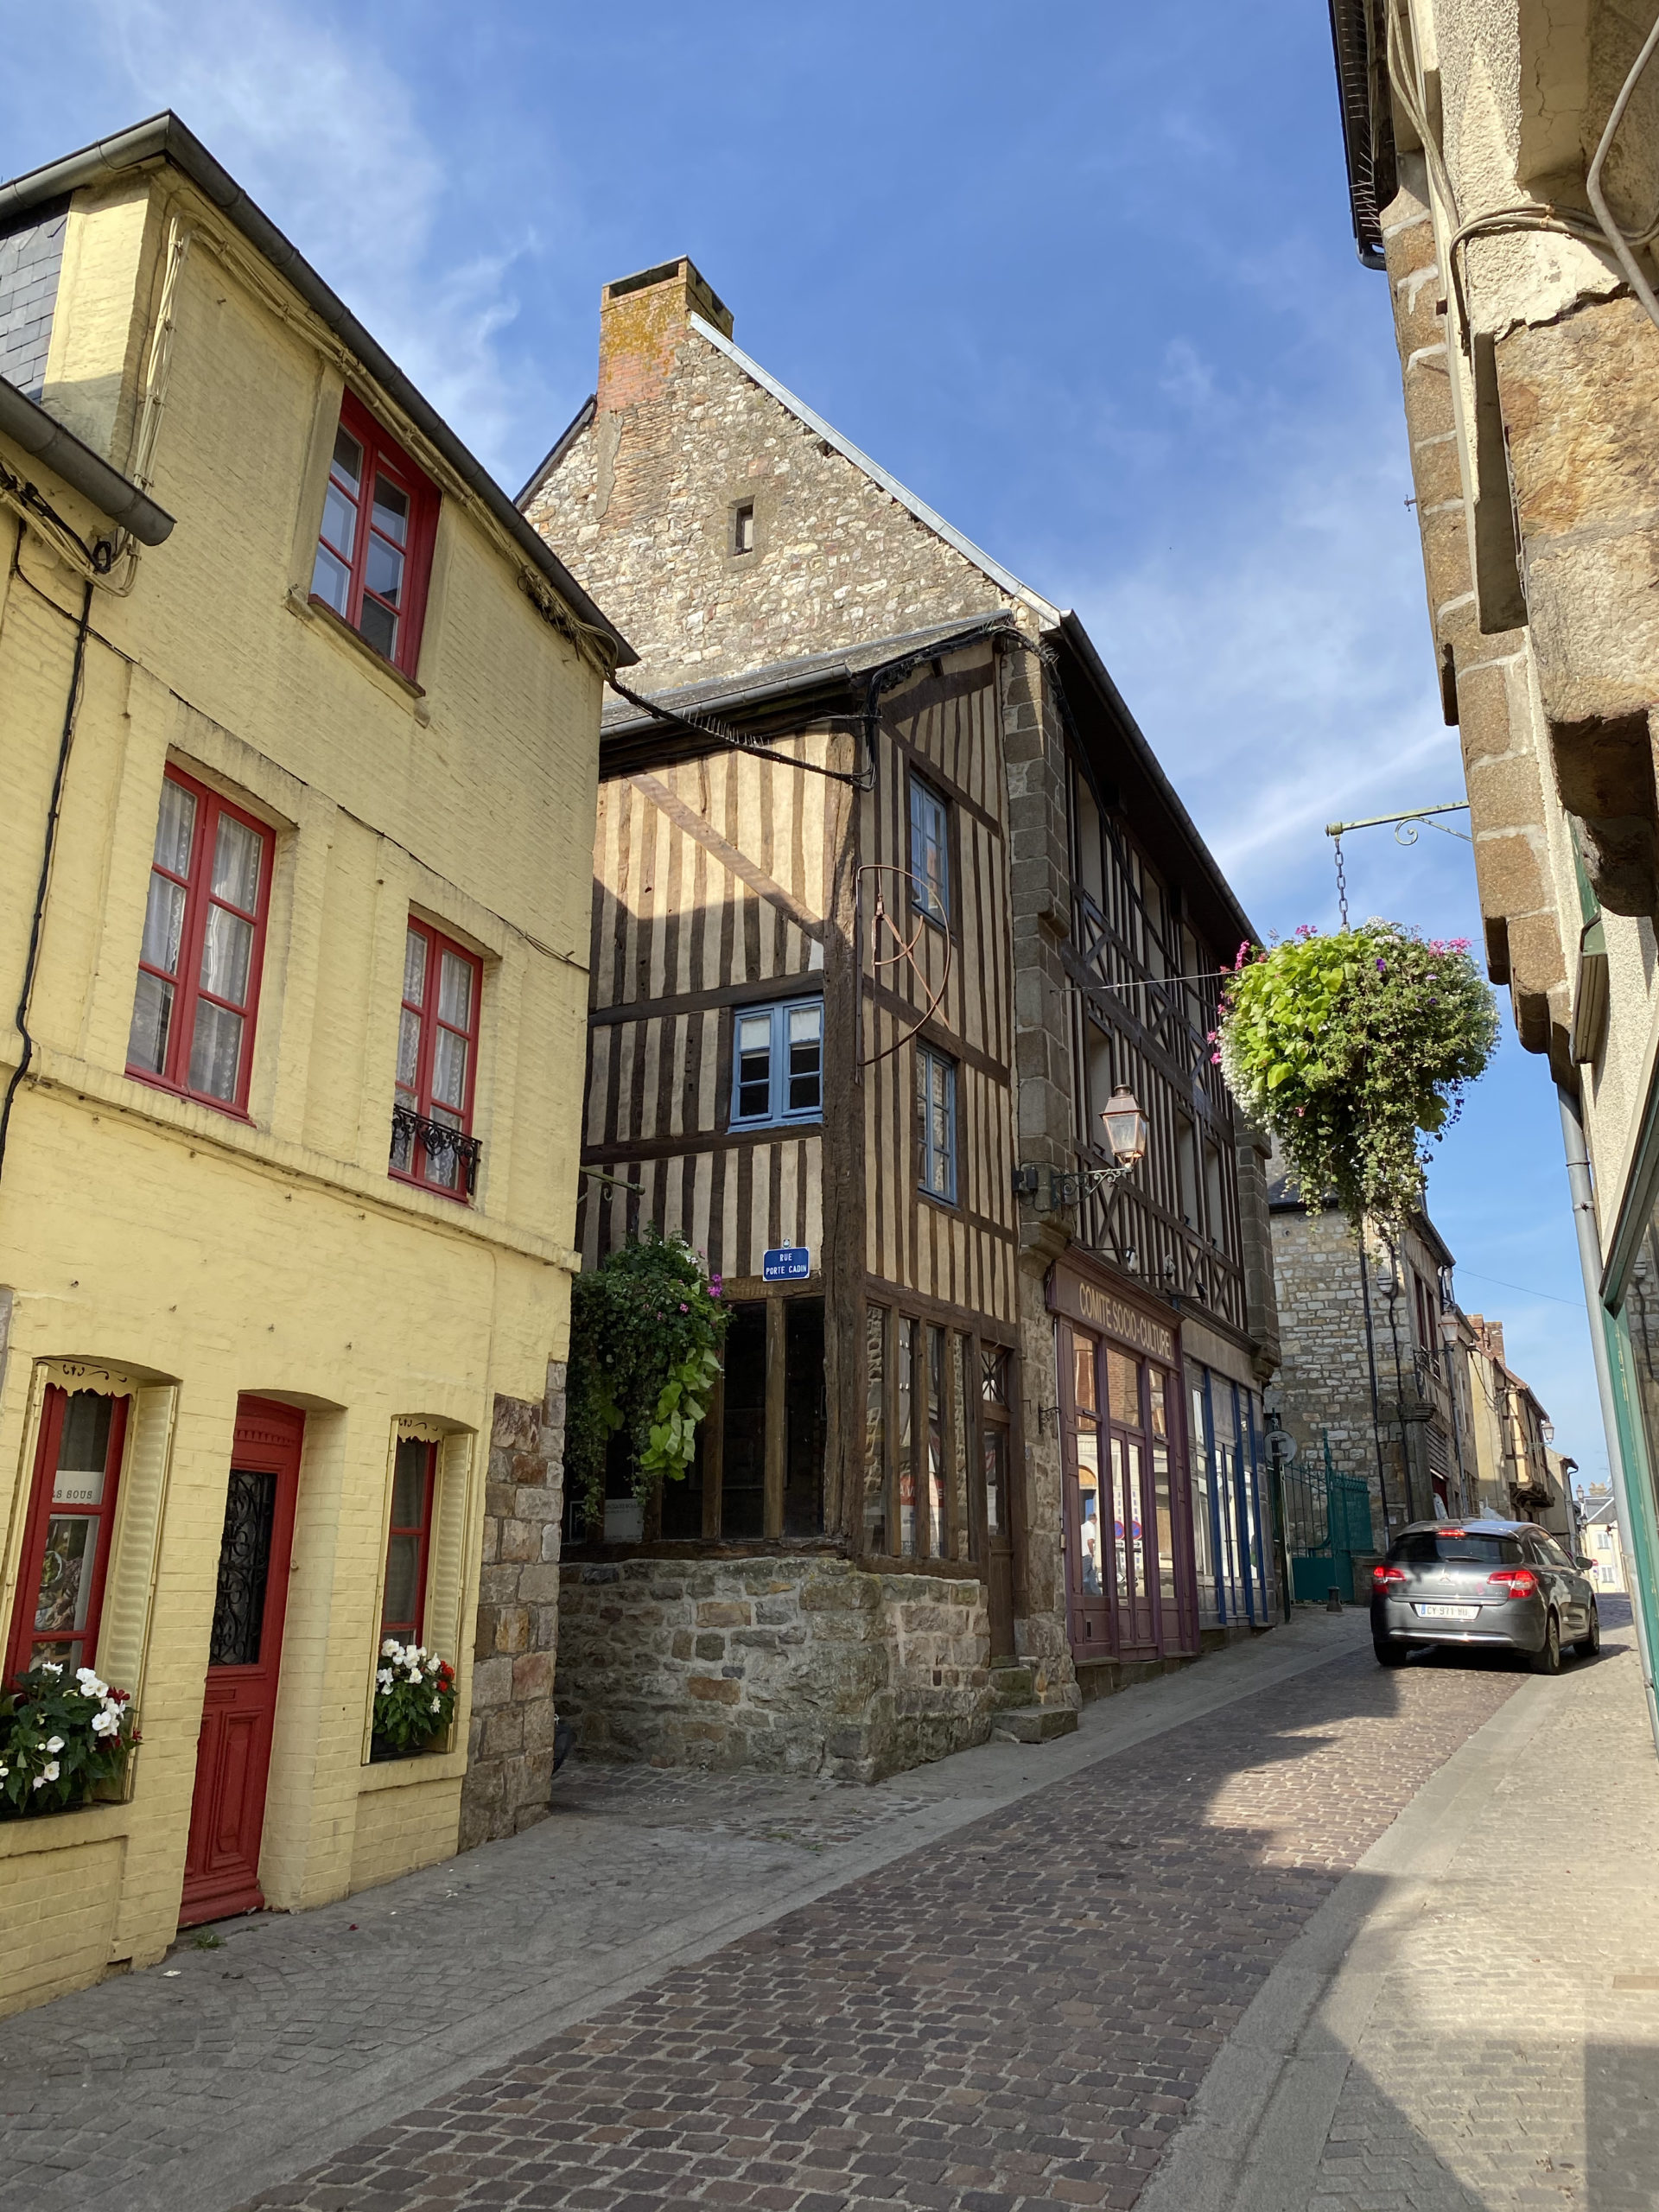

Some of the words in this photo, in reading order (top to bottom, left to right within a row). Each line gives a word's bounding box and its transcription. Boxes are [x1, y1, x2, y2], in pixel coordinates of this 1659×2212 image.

[779, 1253, 792, 1262] RUE
[766, 1266, 785, 1275] PORTE
[788, 1264, 807, 1274] CADIN
[1079, 1282, 1112, 1329] COMITE
[66, 1490, 92, 1499] SOUS
